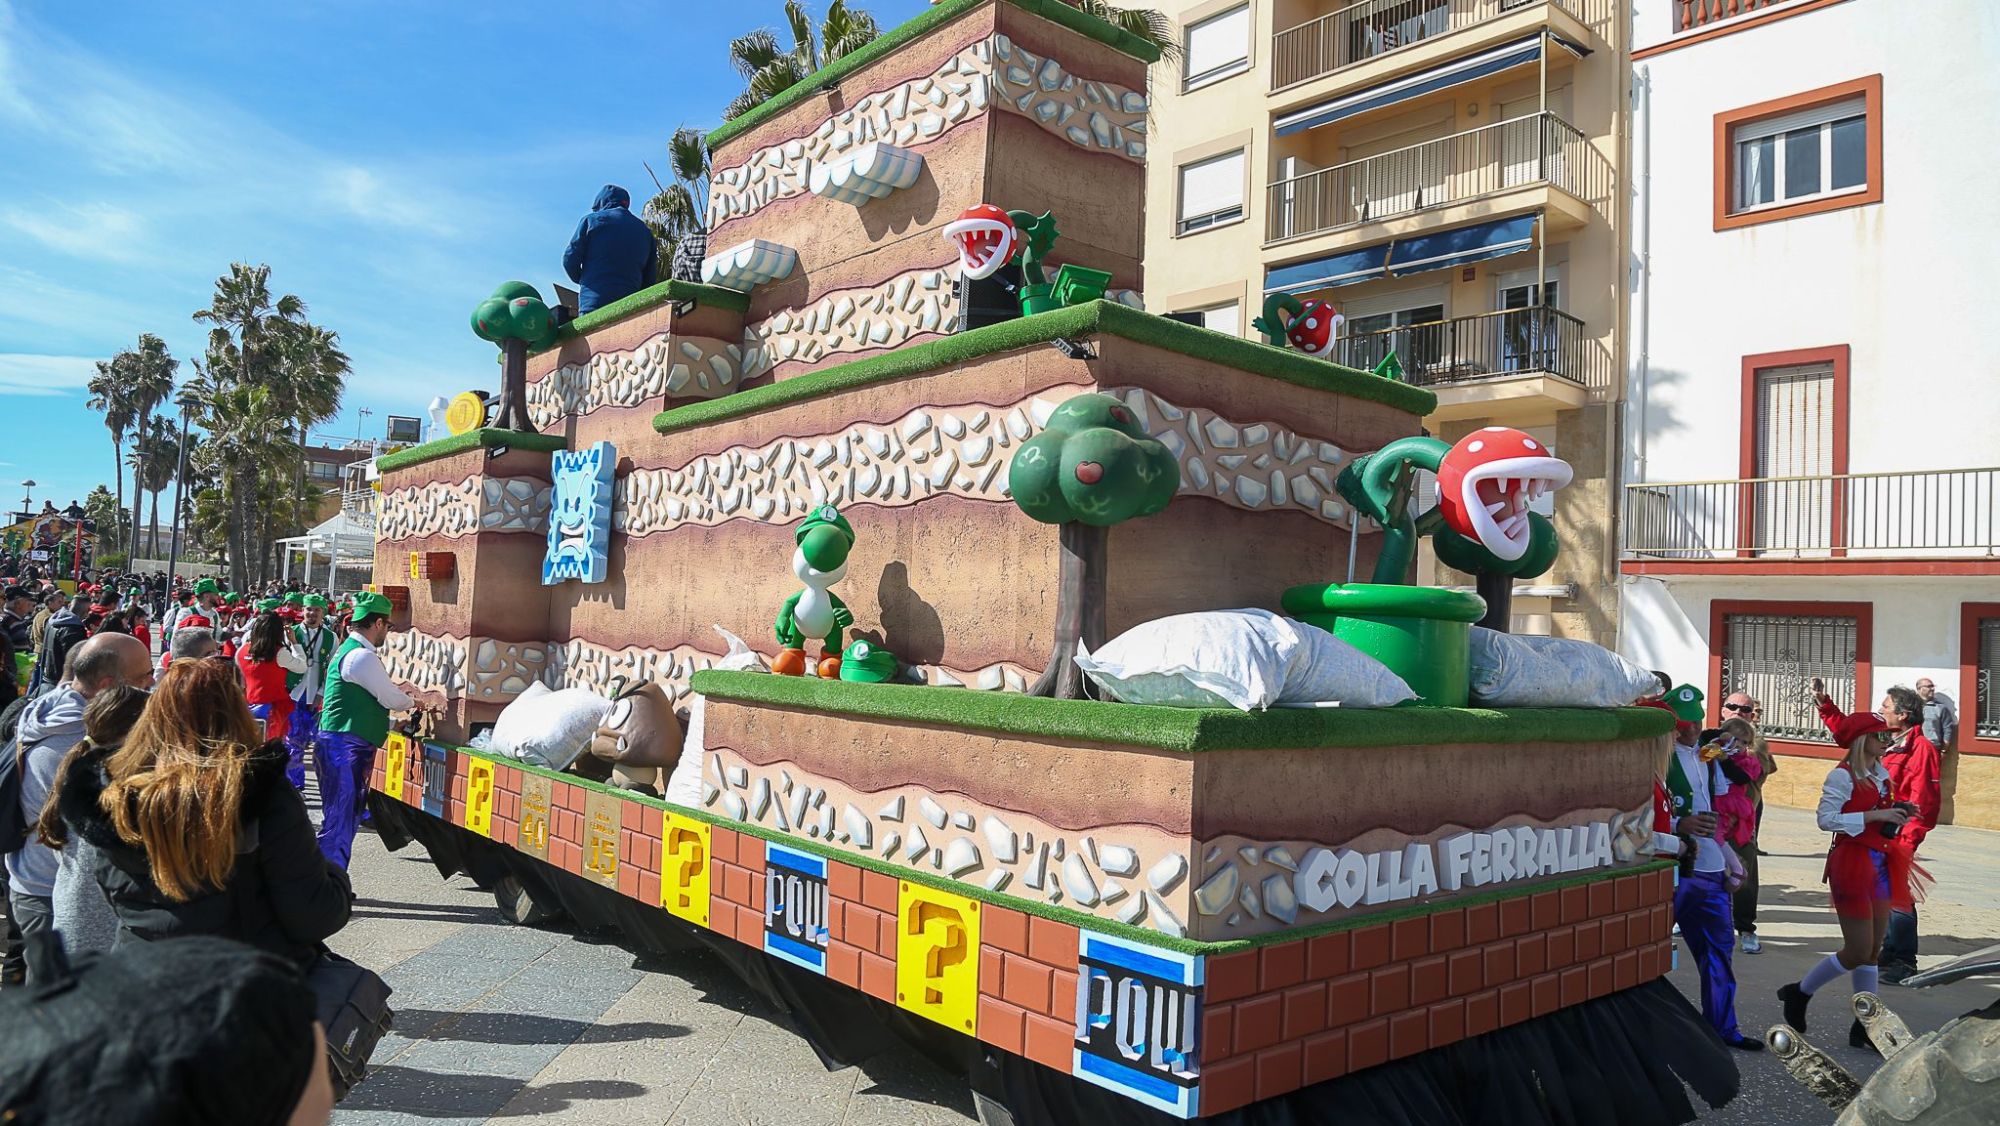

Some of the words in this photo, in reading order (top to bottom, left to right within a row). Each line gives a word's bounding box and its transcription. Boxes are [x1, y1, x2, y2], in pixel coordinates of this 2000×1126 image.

[586, 836, 617, 879] 15
[669, 826, 703, 907] ?
[1296, 844, 1438, 913] COLLA
[1440, 822, 1613, 891] FERRALLA
[765, 867, 828, 948] POW
[908, 898, 967, 1005] ?
[1074, 963, 1200, 1080] POW
